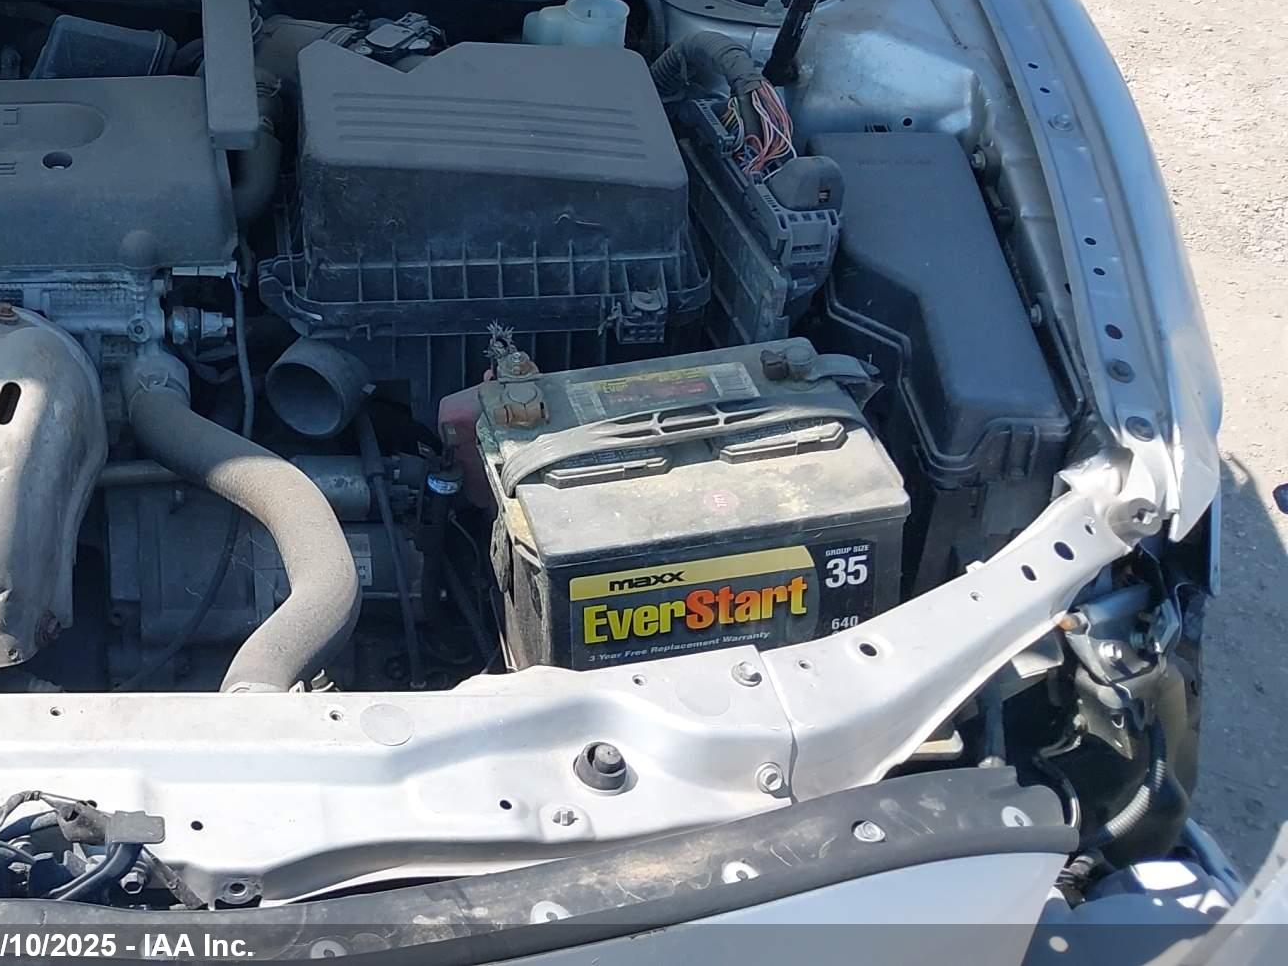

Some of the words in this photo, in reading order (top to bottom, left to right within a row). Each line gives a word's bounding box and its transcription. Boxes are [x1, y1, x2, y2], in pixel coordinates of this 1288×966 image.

[825, 547, 852, 557] GROUP
[853, 544, 870, 553] SIZE
[609, 571, 685, 592] maxx
[825, 555, 868, 588] 35
[583, 575, 808, 645] EverStart
[831, 615, 859, 630] 640
[599, 652, 622, 661] Year
[624, 648, 648, 658] Free
[650, 638, 720, 654] Replacement
[723, 631, 771, 643] Warranty
